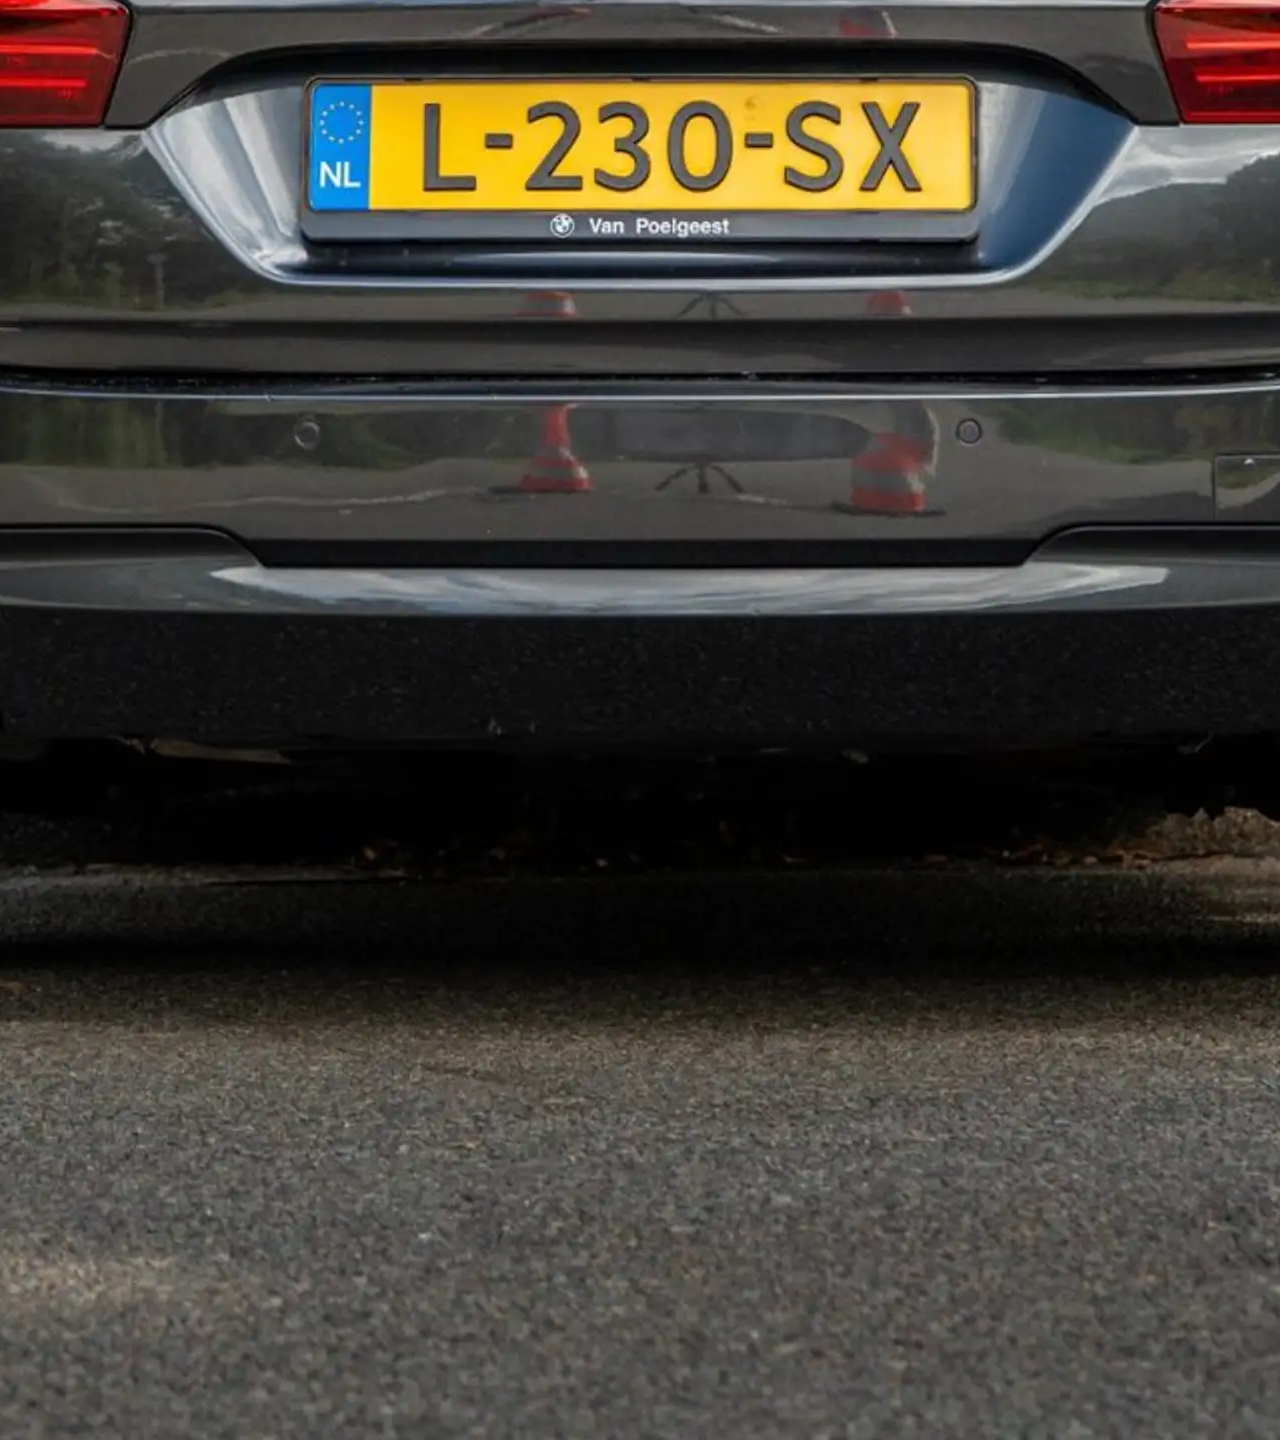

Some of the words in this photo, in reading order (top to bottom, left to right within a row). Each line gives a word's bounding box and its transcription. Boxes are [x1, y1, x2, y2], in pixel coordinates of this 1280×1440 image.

[422, 101, 922, 192] L-230-SX
[319, 162, 361, 188] NL
[589, 217, 625, 234] Van
[636, 217, 730, 237] Poelgeest
